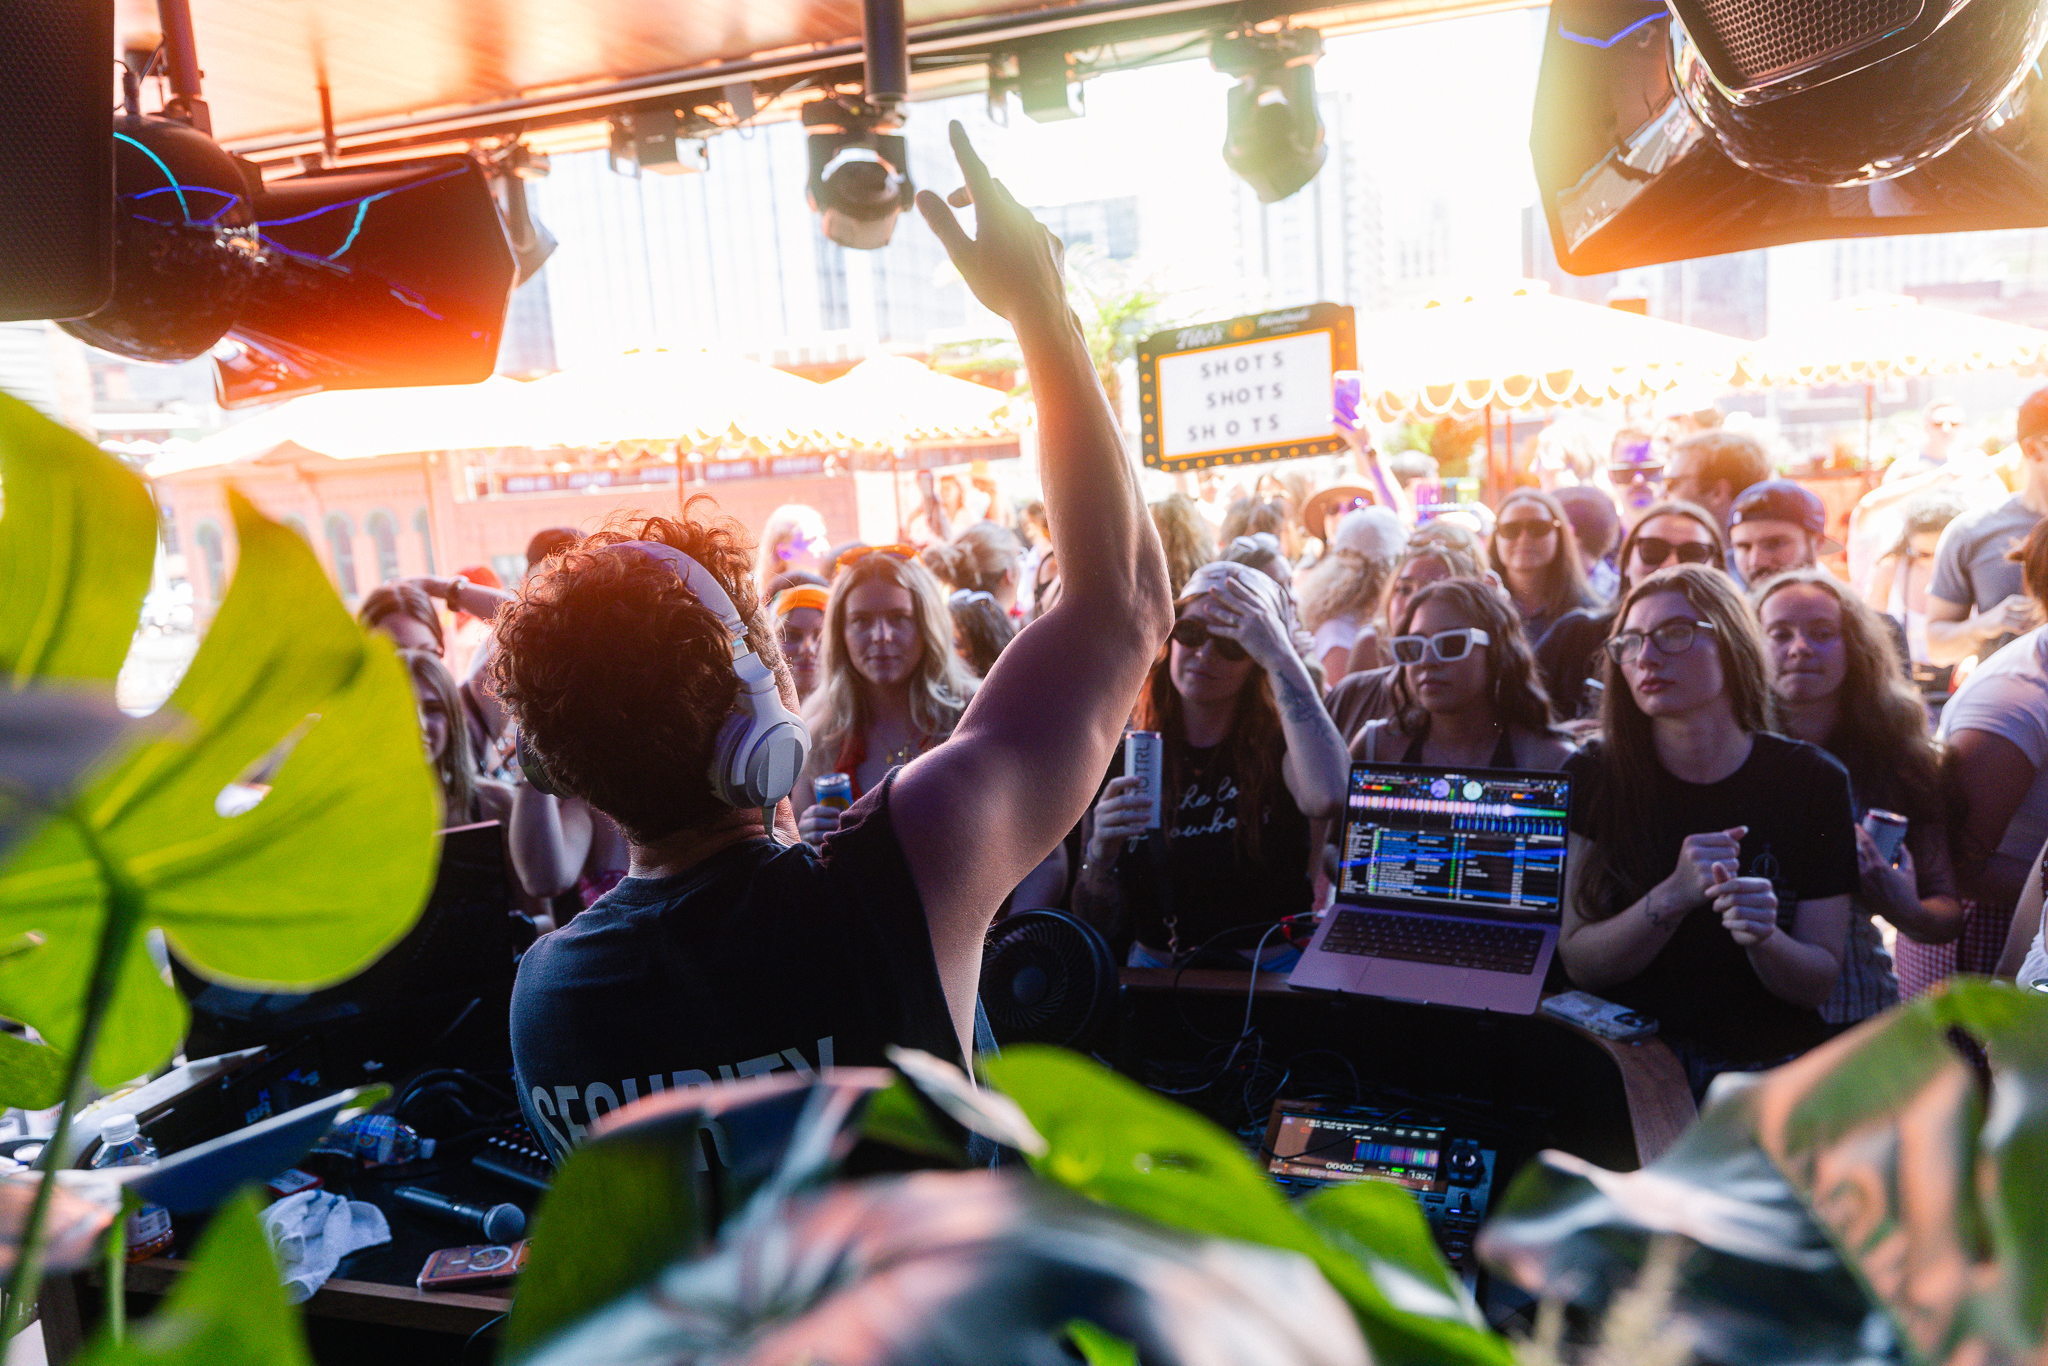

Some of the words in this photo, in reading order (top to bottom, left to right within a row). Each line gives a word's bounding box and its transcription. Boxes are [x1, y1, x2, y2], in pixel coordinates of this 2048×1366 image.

[1201, 352, 1284, 379] SHOTS
[1206, 382, 1283, 409] SHOTS
[1188, 415, 1279, 441] SHOTS
[531, 1036, 834, 1172] SECRY
